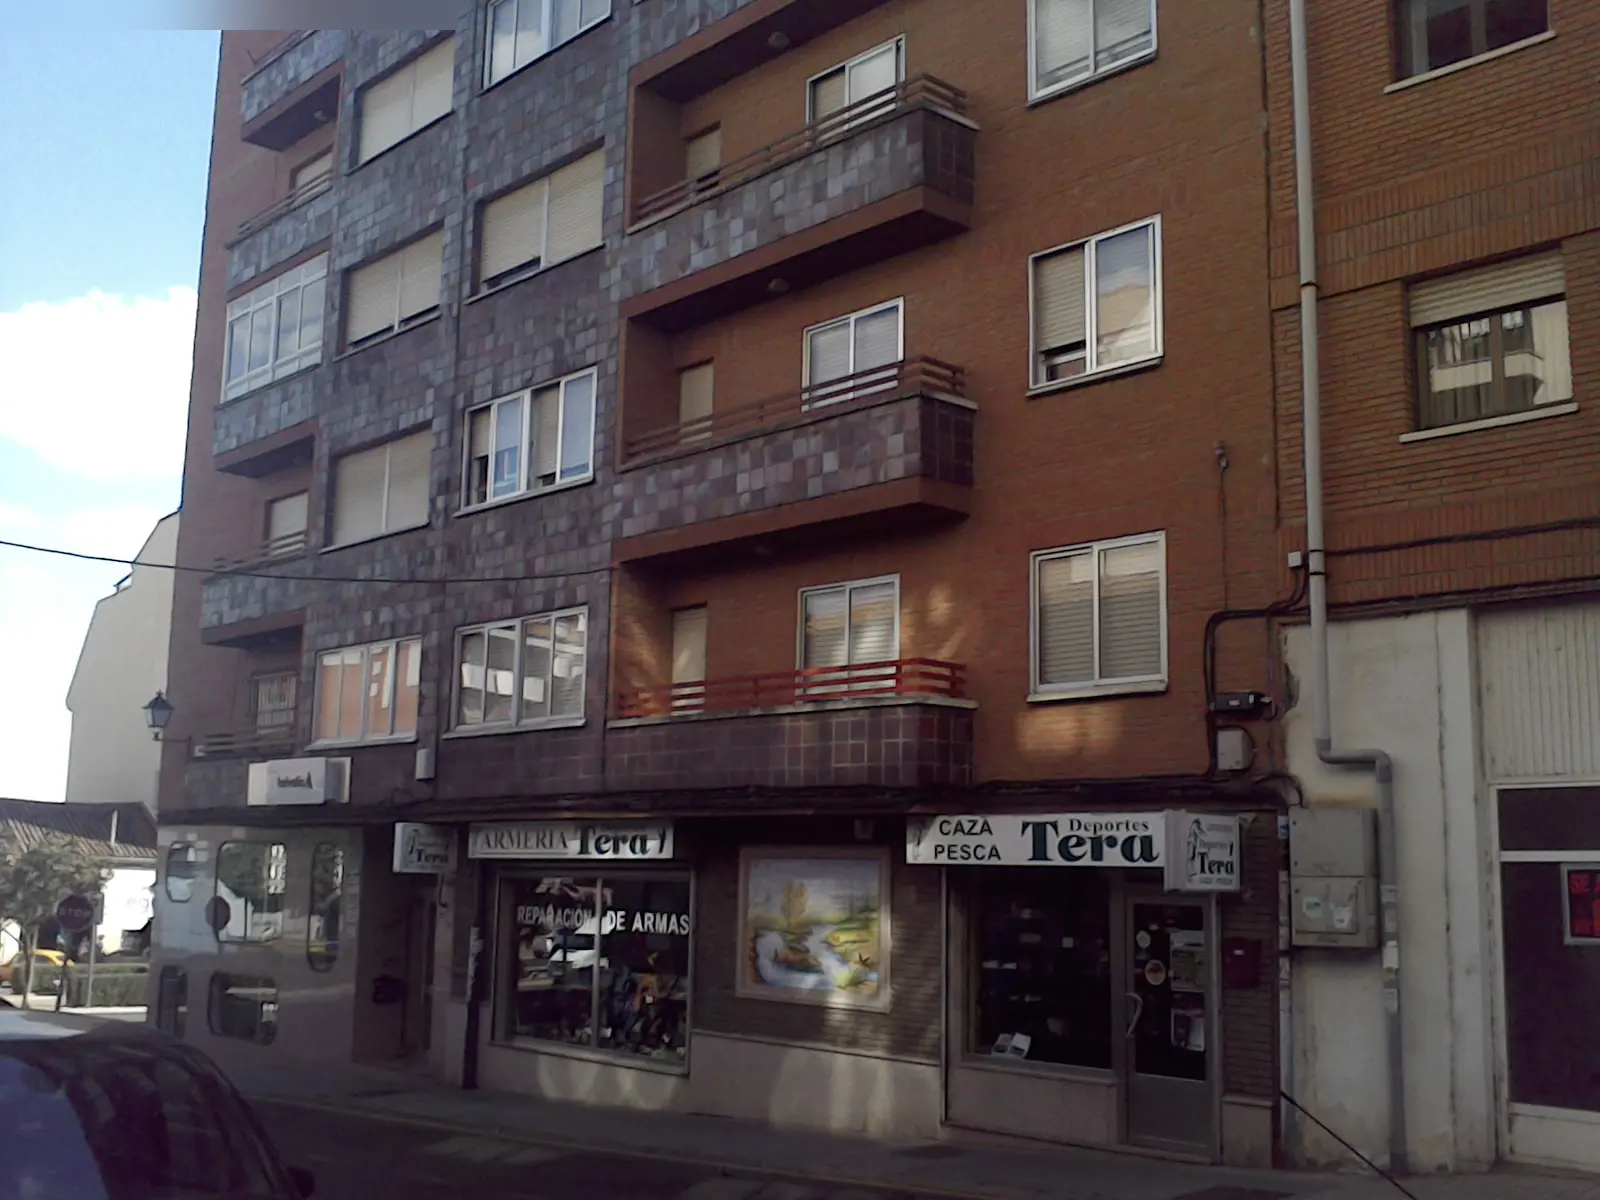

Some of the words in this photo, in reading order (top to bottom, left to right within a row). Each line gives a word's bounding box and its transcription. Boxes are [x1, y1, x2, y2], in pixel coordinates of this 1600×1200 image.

[938, 819, 994, 836] CAZA
[1069, 817, 1149, 833] Deportes
[573, 824, 650, 855] Tera
[1021, 819, 1159, 862] Tera
[933, 843, 1002, 861] PESCA
[1197, 851, 1235, 875] Tera
[606, 910, 627, 931] DE
[632, 911, 690, 936] ARMAS
